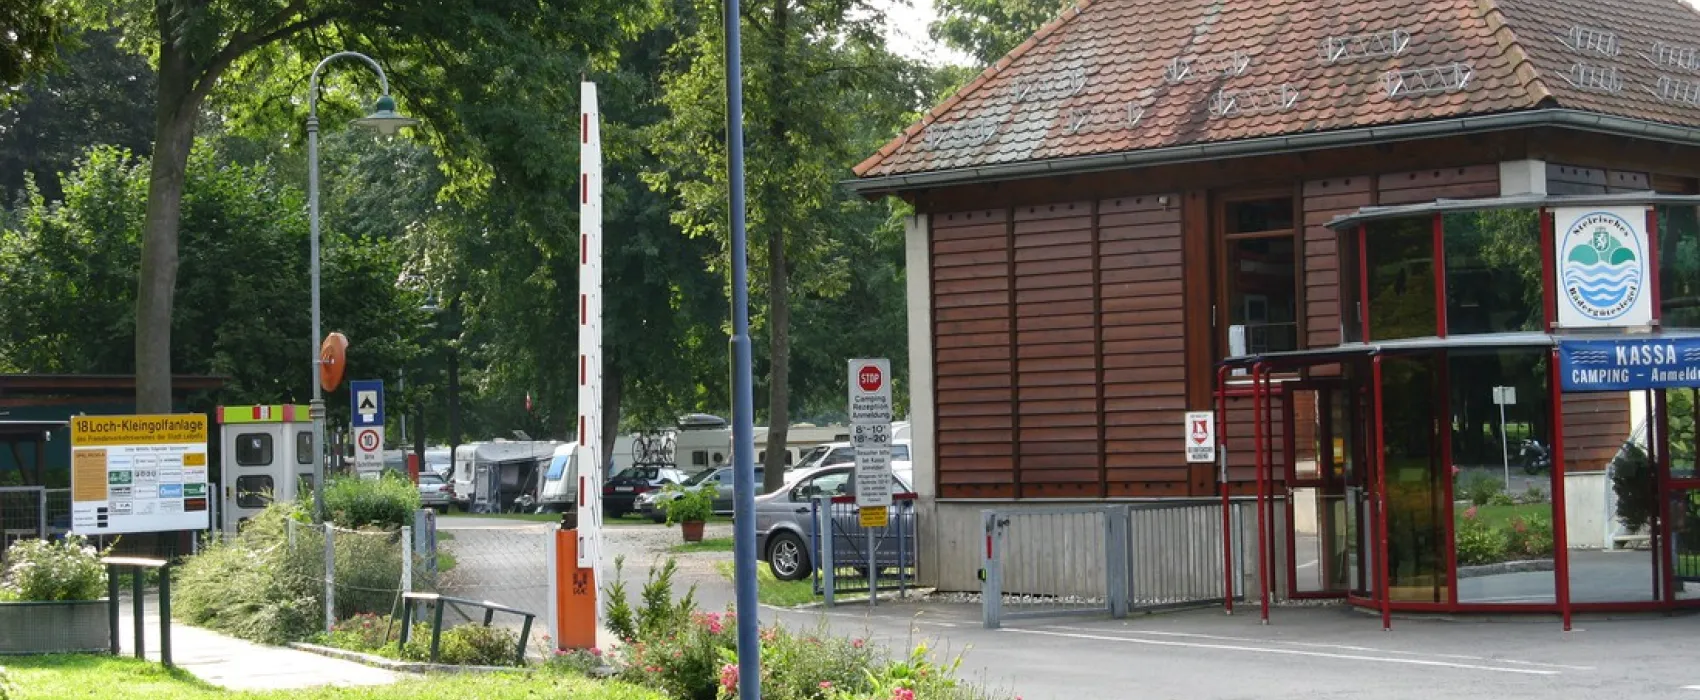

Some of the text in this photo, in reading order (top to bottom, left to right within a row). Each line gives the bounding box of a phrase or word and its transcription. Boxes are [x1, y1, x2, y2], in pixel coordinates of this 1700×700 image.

[1573, 215, 1628, 237] Steirisches
[1615, 344, 1678, 366] KASSA
[860, 373, 880, 384] STOP
[1571, 368, 1630, 384] CAMPING
[854, 395, 886, 403] Camping
[364, 435, 372, 446] 10
